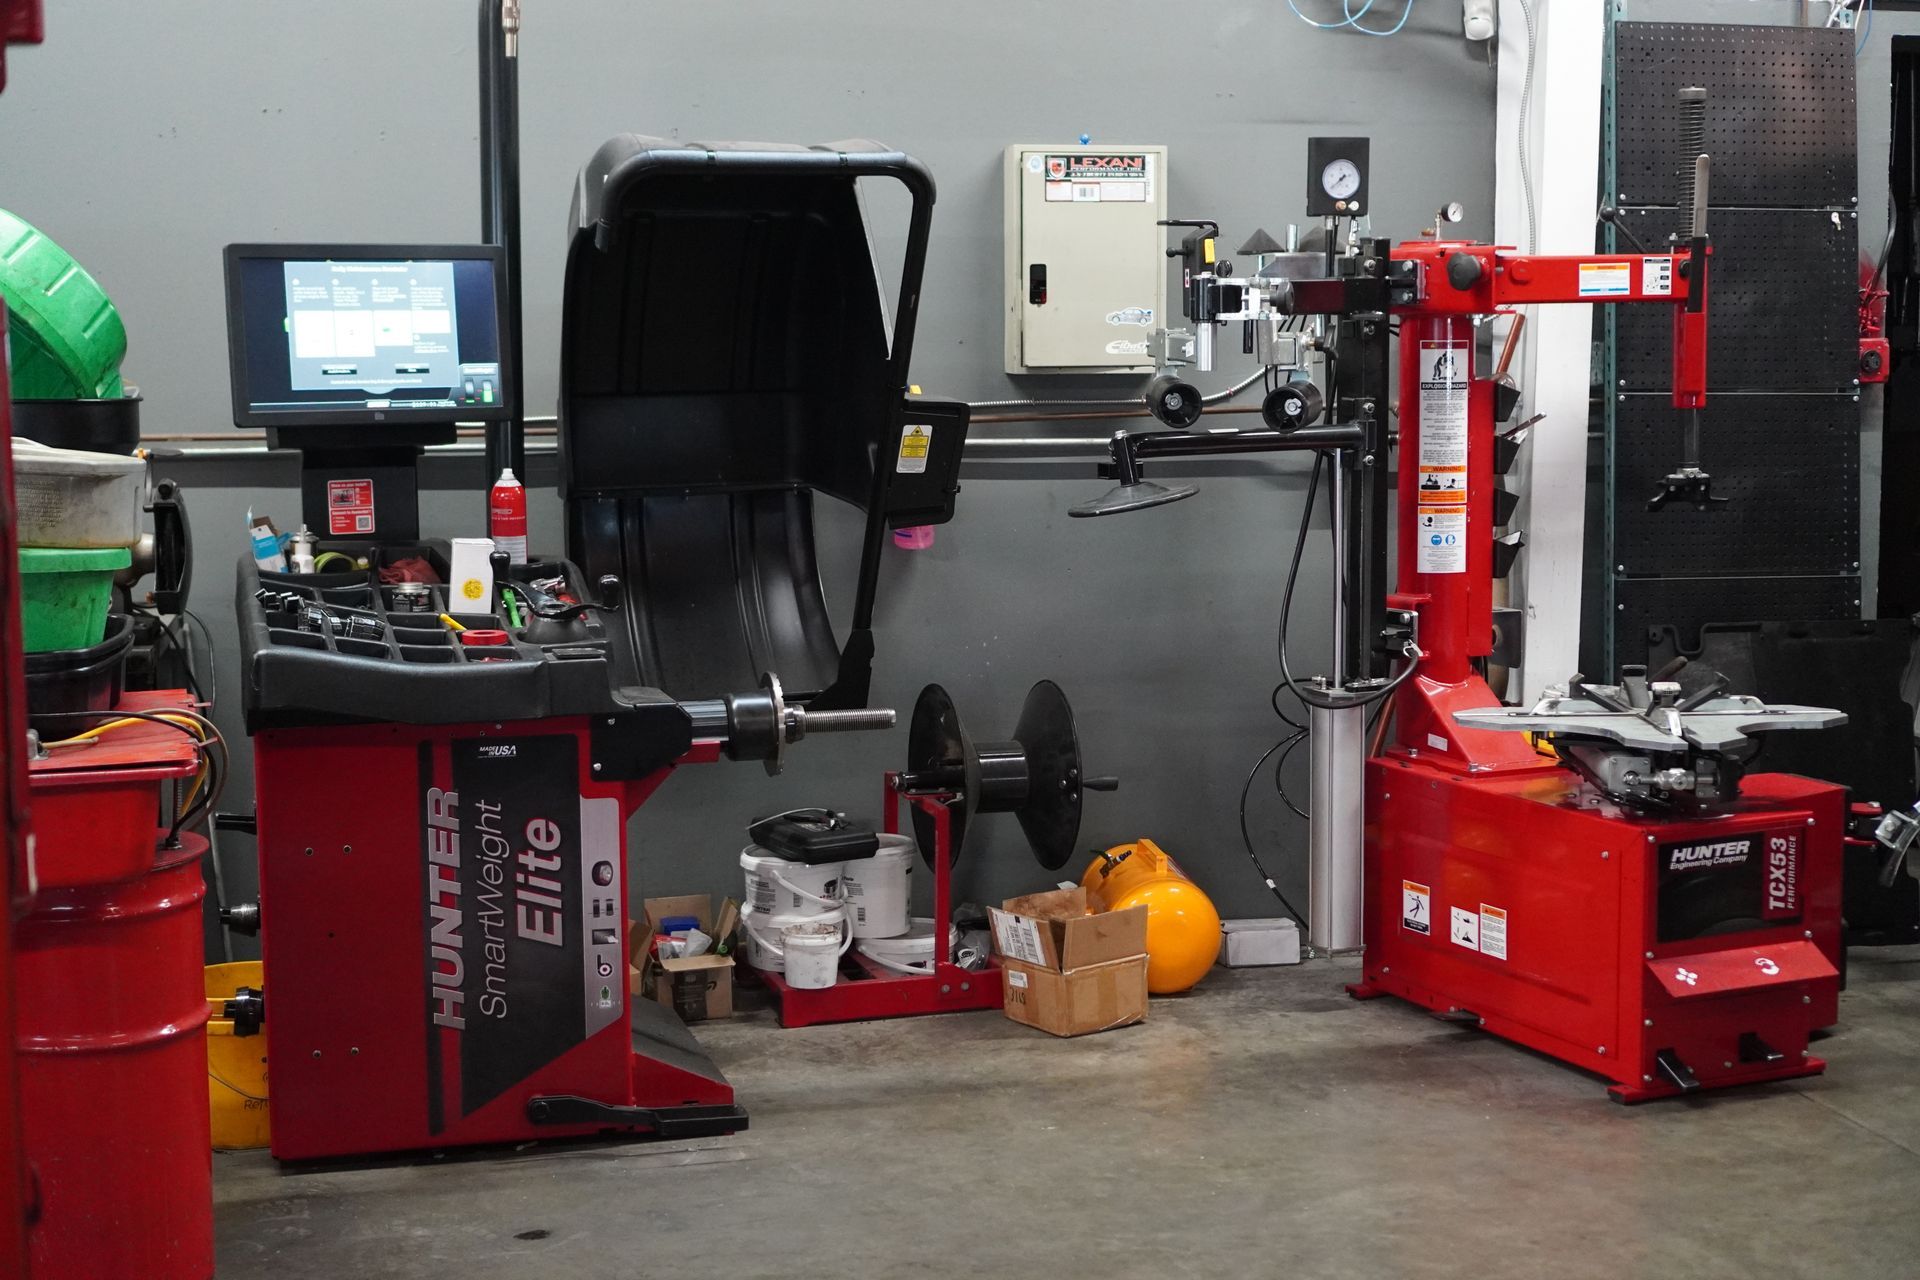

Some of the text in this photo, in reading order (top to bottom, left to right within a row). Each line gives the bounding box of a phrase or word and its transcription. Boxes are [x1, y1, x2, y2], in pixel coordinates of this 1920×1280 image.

[1070, 157, 1143, 168] LEXANI
[495, 745, 516, 756] USA
[516, 818, 563, 947] Elite
[1670, 854, 1748, 870] Engineering Company
[1671, 841, 1750, 861] HUNTER
[1768, 837, 1787, 910] TCX53
[1786, 835, 1797, 909] PERFORMANCE
[427, 787, 465, 1030] HUNTER
[475, 800, 509, 1018] SmartWeight
